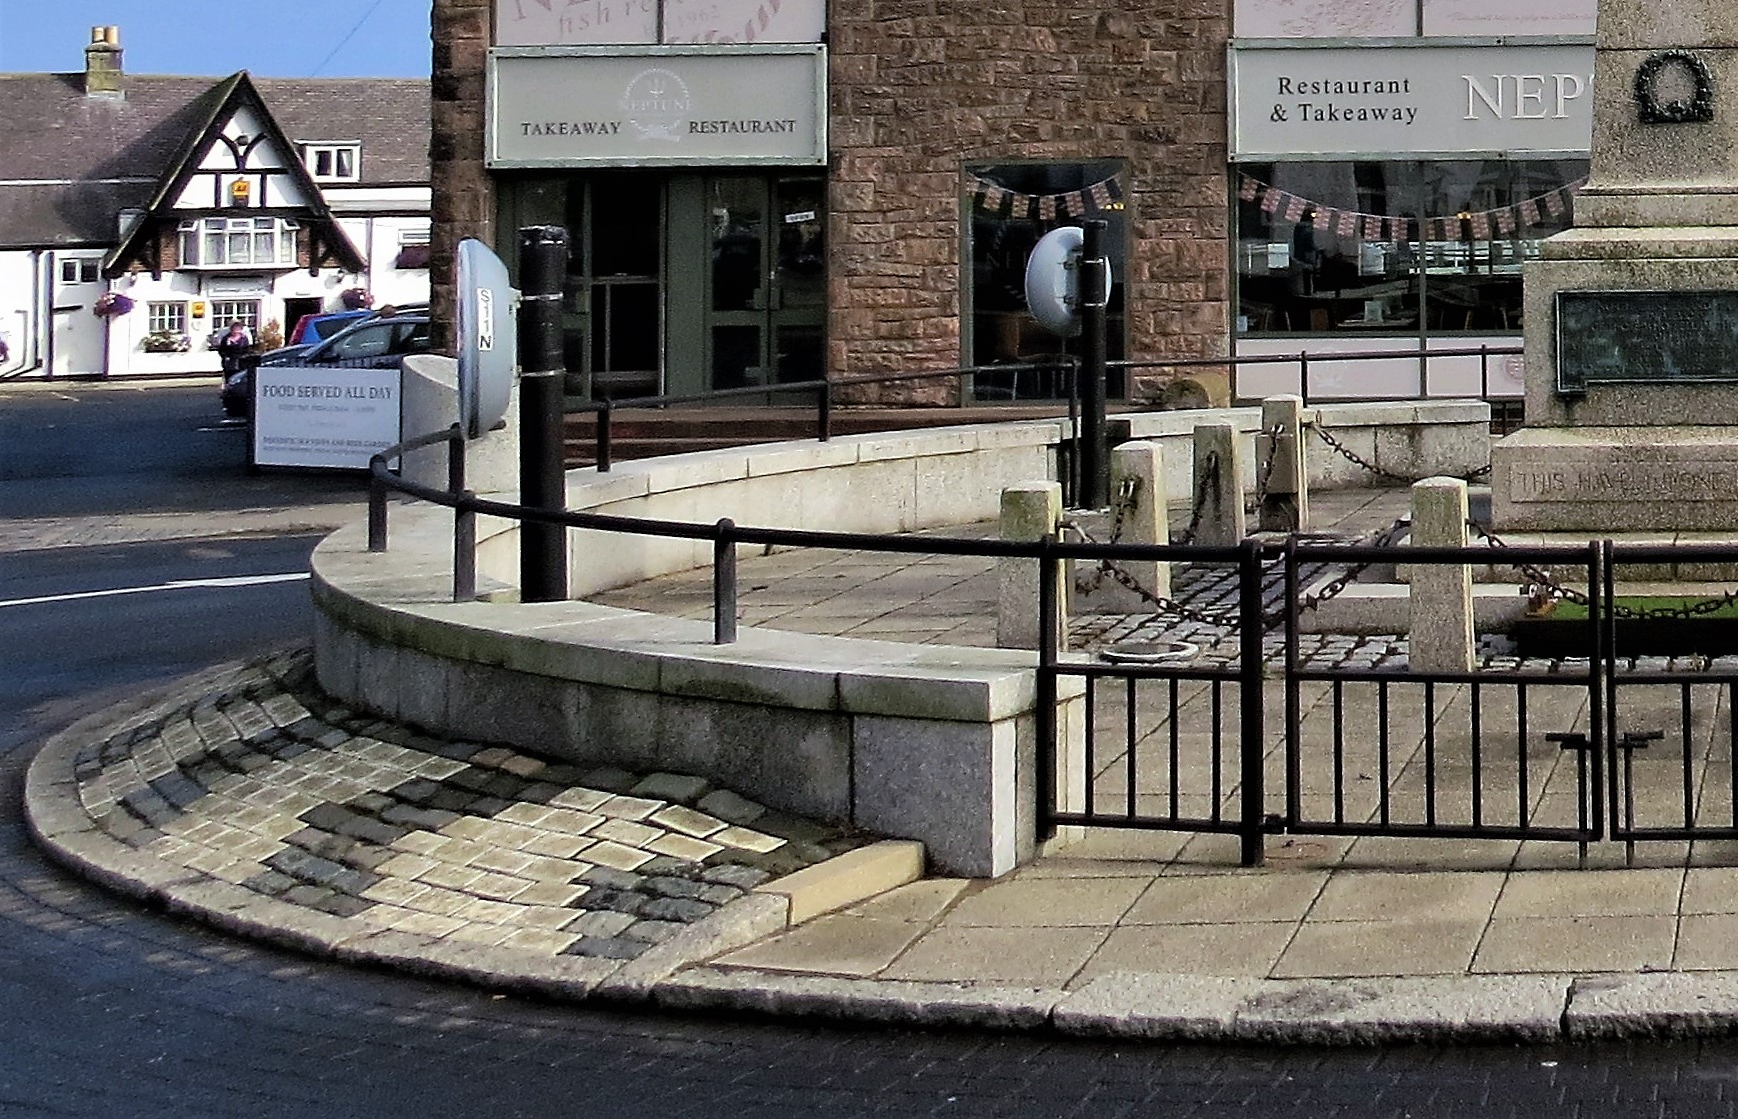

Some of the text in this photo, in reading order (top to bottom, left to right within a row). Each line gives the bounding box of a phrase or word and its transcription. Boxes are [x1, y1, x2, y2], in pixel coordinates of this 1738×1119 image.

[1278, 76, 1411, 95] Restaurant
[1462, 73, 1595, 120] NEP
[1270, 103, 1419, 125] & Takeaway
[521, 119, 797, 136] TAKEAWAY RESTAURANT
[263, 384, 393, 400] FOOD SERVED ALL DAY
[1518, 472, 1566, 492] THIS
